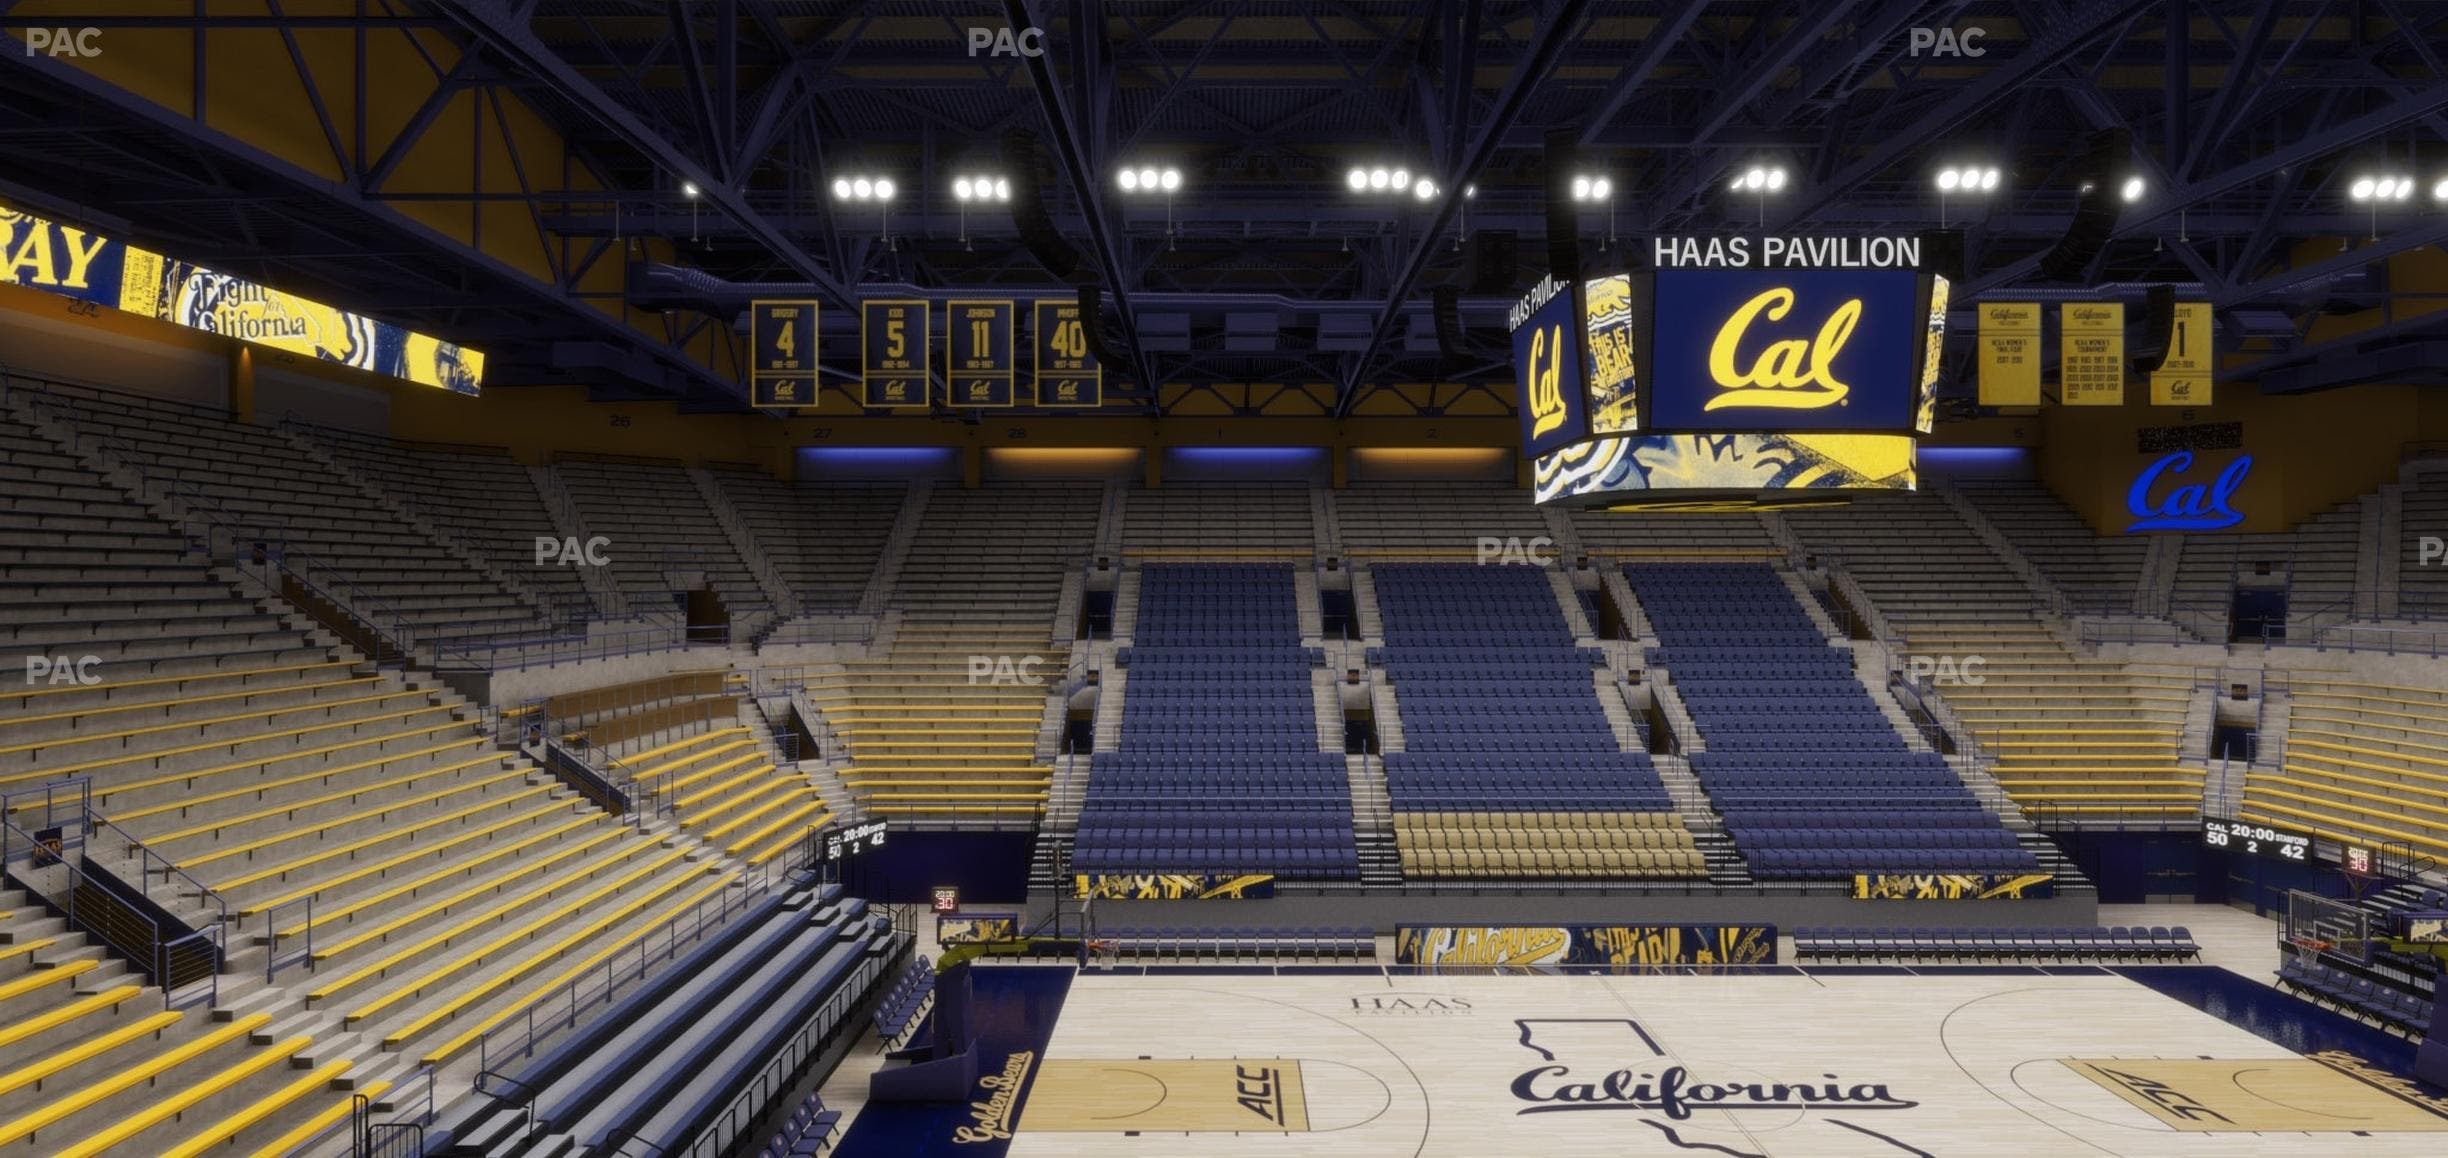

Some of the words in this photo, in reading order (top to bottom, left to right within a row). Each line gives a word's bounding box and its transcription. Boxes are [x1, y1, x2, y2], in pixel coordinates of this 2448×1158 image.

[1655, 237, 1750, 267] HAAS
[1763, 237, 1920, 267] PAVILION
[1509, 294, 1530, 333] HAAS
[776, 320, 795, 357] 4
[887, 320, 905, 358] 5
[971, 320, 990, 358] 11
[1050, 320, 1087, 358] 40
[1704, 287, 1863, 412] Cal
[2177, 321, 2185, 357] 1
[774, 379, 796, 396] Cal
[885, 379, 907, 396] Cal
[969, 379, 991, 396] Cal
[1057, 379, 1079, 396] Cal
[1529, 324, 1567, 440] Cal
[2171, 379, 2192, 395] Cal
[814, 427, 833, 439] 27
[2124, 450, 2253, 534] Cal
[843, 825, 869, 842] 20:00
[852, 842, 859, 854] 2
[871, 832, 884, 845] 42
[2206, 823, 2228, 833] CAL
[2230, 824, 2275, 842] 20:00
[2206, 831, 2228, 846] 50
[2247, 841, 2257, 853] 2
[2280, 844, 2304, 860] 42
[935, 898, 953, 909] 30
[1352, 998, 1472, 1010] HAAS
[1236, 1064, 1273, 1122] ACC
[1510, 1065, 1920, 1121] California
[2101, 1067, 2240, 1127] ACC
